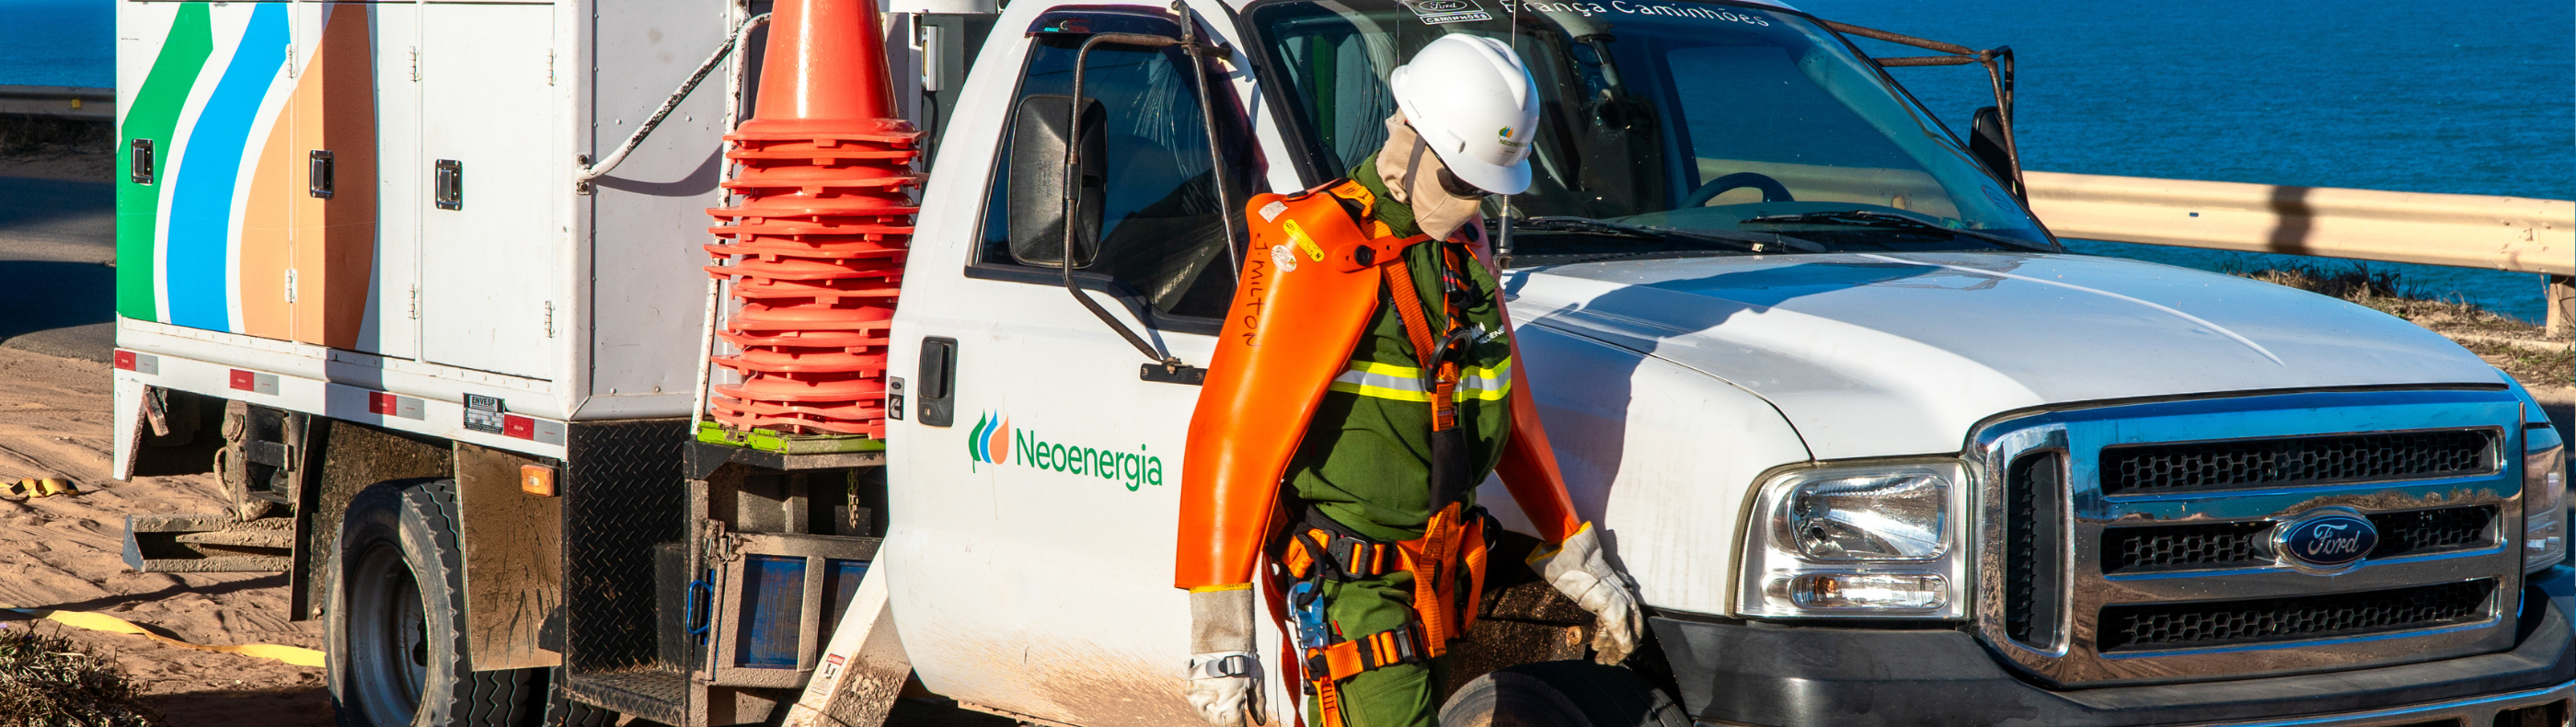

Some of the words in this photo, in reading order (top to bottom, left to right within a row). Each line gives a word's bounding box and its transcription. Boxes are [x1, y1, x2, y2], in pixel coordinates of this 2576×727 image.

[1426, 13, 1488, 23] CAMINHÕES
[1499, 0, 1607, 17] França
[1612, 1, 1770, 27] Caminhões
[1478, 324, 1505, 345] NEOENE
[472, 396, 496, 406] ENVESP
[1017, 428, 1163, 492] Neoenergia
[2307, 524, 2361, 556] Ford
